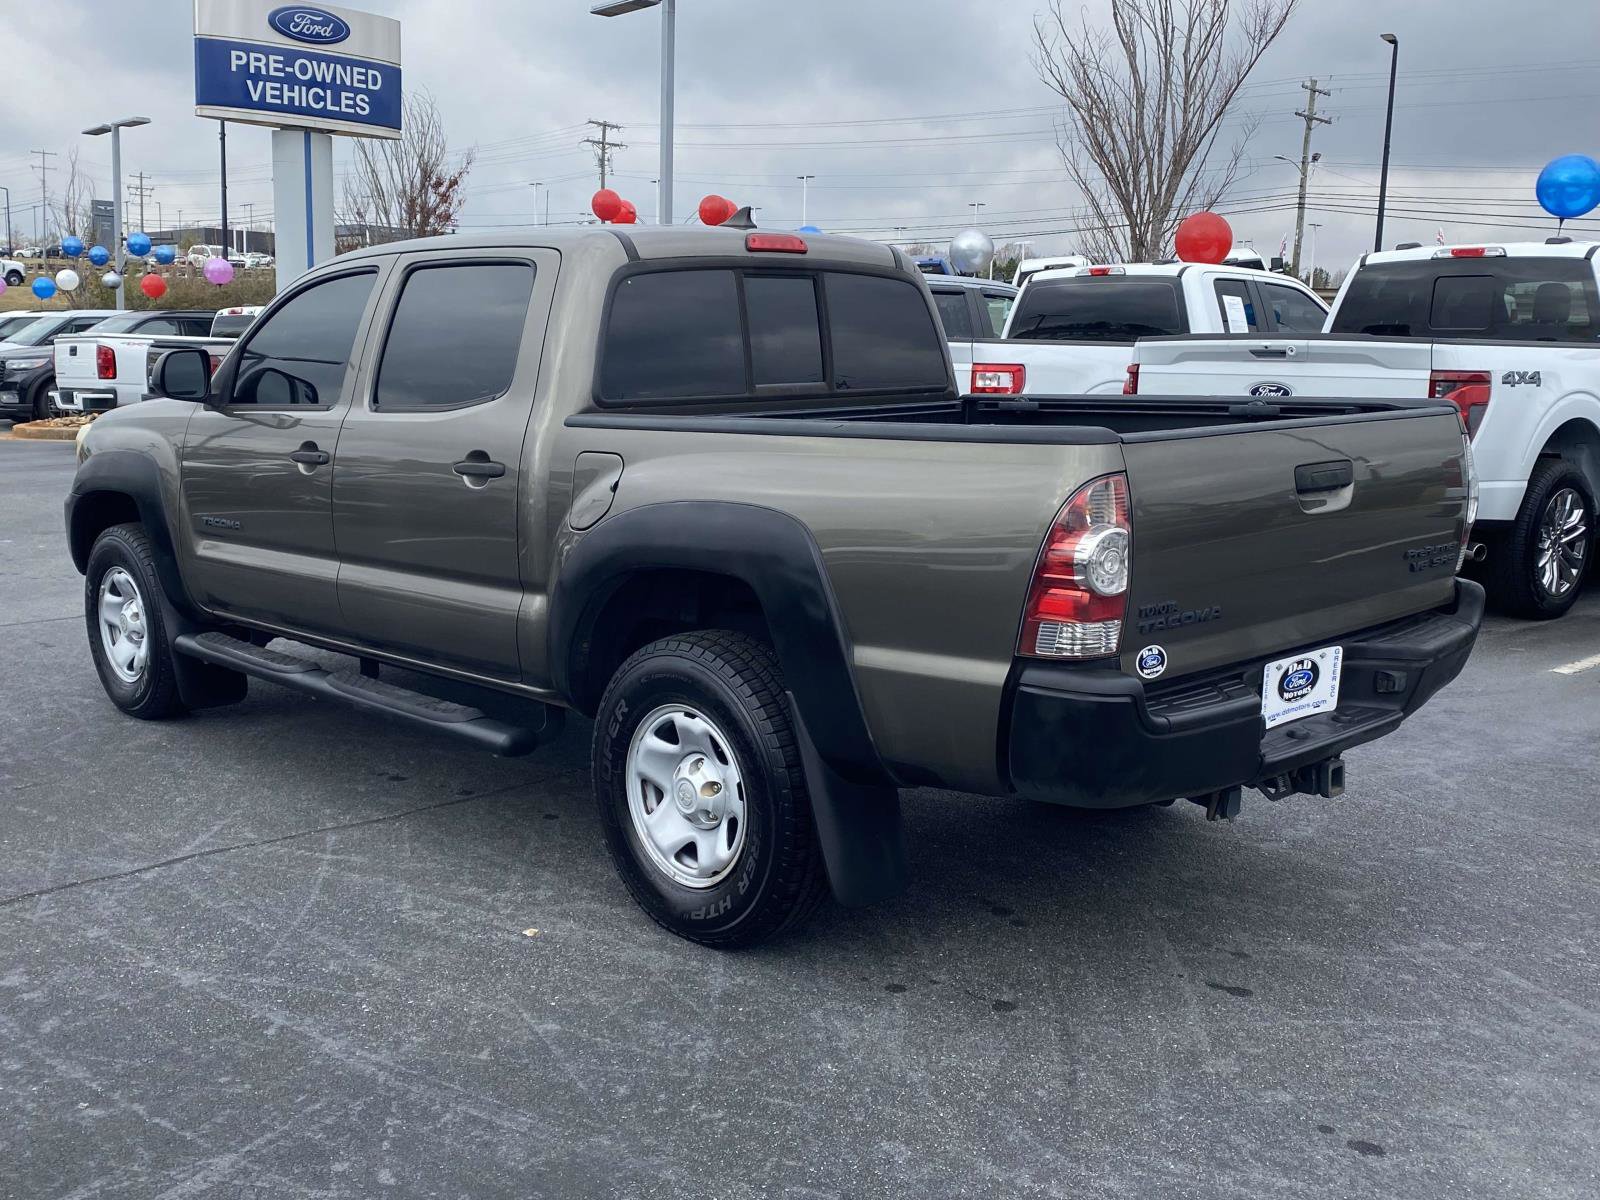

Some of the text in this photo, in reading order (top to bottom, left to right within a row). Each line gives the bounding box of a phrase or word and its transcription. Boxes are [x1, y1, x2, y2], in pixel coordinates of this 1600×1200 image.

[289, 13, 333, 37] Ford
[230, 50, 382, 91] PRE-OWNED
[246, 79, 370, 116] VEHICLES
[201, 516, 241, 529] TACOMA
[1138, 601, 1178, 617] TOYOTA
[1137, 606, 1221, 632] TACOMA
[1289, 660, 1311, 674] D&D
[1289, 674, 1307, 688] Ford
[1283, 686, 1311, 699] MOTORS
